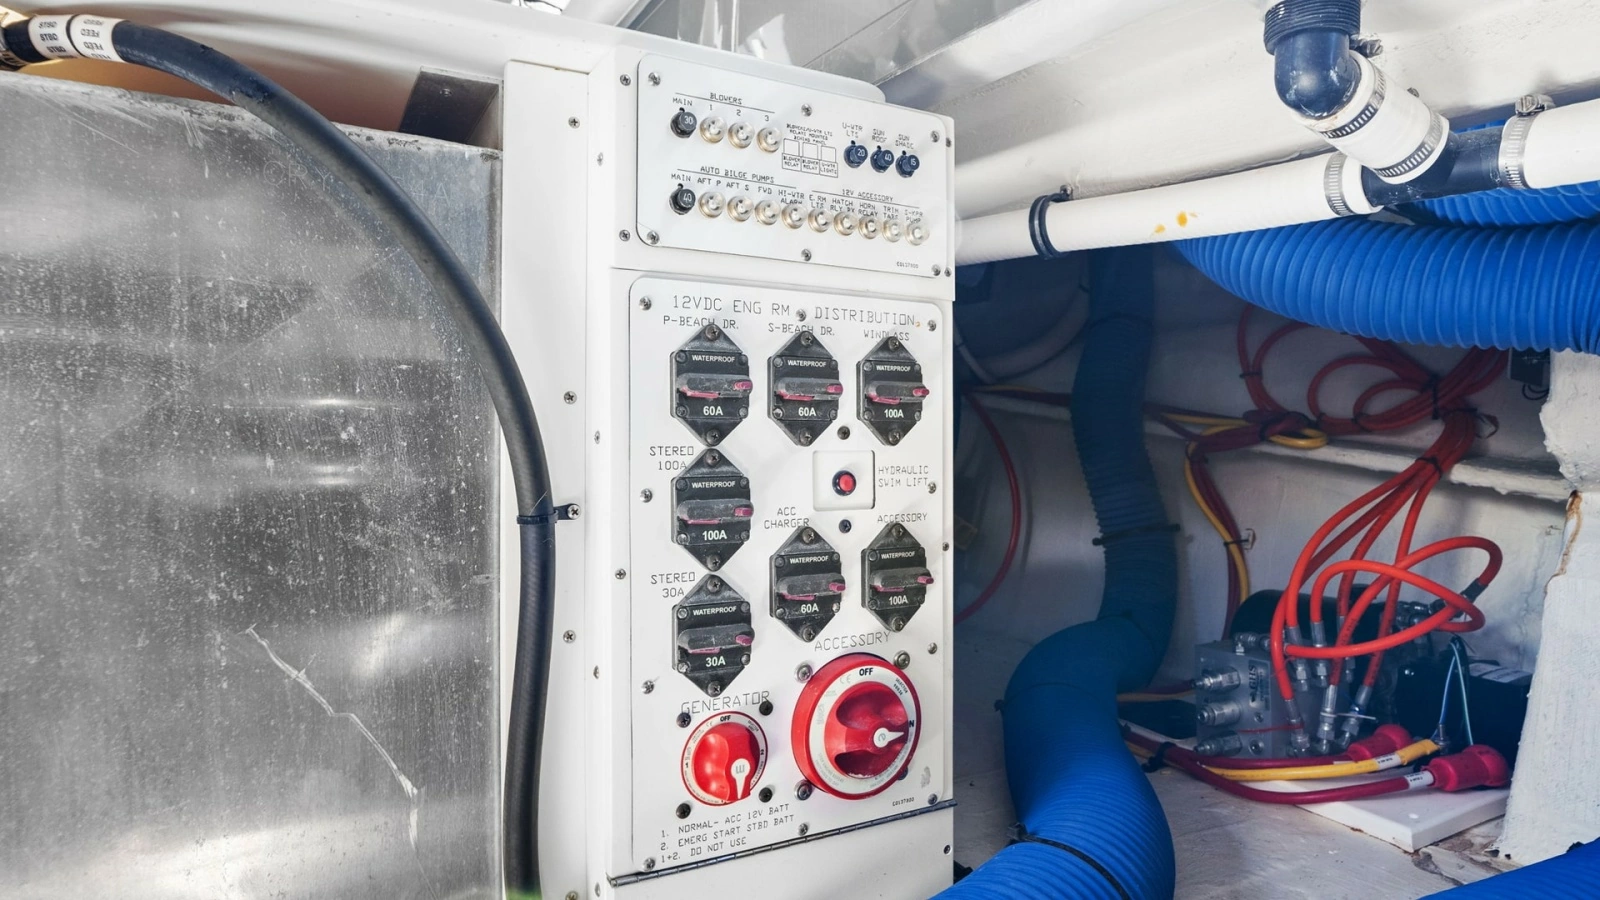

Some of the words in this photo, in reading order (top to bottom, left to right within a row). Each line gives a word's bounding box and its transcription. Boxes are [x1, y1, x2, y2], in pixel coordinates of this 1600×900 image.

[40, 33, 58, 41] STBD
[80, 28, 100, 37] FEED
[83, 41, 104, 50] FEED
[672, 97, 693, 106] MAIN
[709, 92, 743, 105] BLOWERS
[684, 116, 694, 125] 30
[842, 122, 863, 131] U-WTR
[846, 130, 859, 138] LTS
[871, 135, 887, 143] ROOF
[857, 148, 866, 156] 20
[671, 173, 691, 182] MAIN
[700, 166, 720, 175] AUTO
[724, 169, 747, 179] BILGE
[751, 173, 775, 183] PUMPS
[697, 177, 712, 185] AFT
[758, 186, 772, 195] FWD
[778, 189, 805, 200] HI-WTR
[842, 188, 854, 196] 12V
[858, 192, 893, 202] ACCESSORY
[683, 193, 692, 201] 40
[832, 198, 854, 206] HATCH
[830, 204, 842, 212] RLY
[860, 202, 876, 210] HORN
[883, 205, 899, 213] TRIM
[858, 209, 878, 217] RELAY
[673, 295, 722, 312] 12VDC
[733, 299, 762, 315] ENG
[771, 303, 790, 316] RM
[815, 306, 915, 326] DISTRIBUTION
[663, 315, 715, 327] P-BEACH
[722, 319, 739, 330] DR.
[768, 323, 814, 334] S-BEACH
[820, 326, 835, 336] DR.
[691, 354, 736, 363] WATERPROOF
[787, 359, 827, 368] WATERPROOF
[876, 364, 911, 372] WATERPROOF
[703, 405, 723, 416] 60A
[798, 406, 816, 417] 60A
[884, 408, 904, 419] 100A
[649, 446, 694, 457] STEREO
[658, 460, 688, 471] 100A
[878, 465, 929, 475] HYDRAULIC
[691, 480, 736, 489] WATERPROOF
[878, 478, 901, 488] SWIM
[906, 477, 928, 487] LIFT
[777, 506, 797, 517] ACC
[877, 512, 928, 524] ACCESSORY
[764, 518, 810, 530] CHARGER
[702, 529, 727, 541] 100A
[789, 555, 829, 564] WATERPROOF
[881, 551, 916, 560] WATERPROOF
[651, 571, 695, 585] STEREO
[662, 587, 685, 598] 30A
[888, 595, 909, 605] 100A
[693, 606, 737, 616] WATERPROOF
[801, 603, 819, 614] 60A
[814, 631, 891, 652] ACCESSORY
[705, 656, 726, 667] 30A
[859, 667, 874, 677] OFF
[681, 690, 770, 715] GENERATOR
[720, 714, 731, 722] OFF
[661, 830, 669, 838] 1.
[725, 813, 742, 824] ACC
[748, 810, 763, 820] 12V
[769, 803, 790, 815] BATT
[660, 842, 668, 851] 2.
[678, 833, 708, 847] EMERG
[713, 826, 741, 840] START
[747, 820, 768, 832] STBD
[774, 814, 795, 826] BATT
[690, 846, 702, 856] DO
[707, 842, 724, 852] NOT
[730, 836, 747, 848] USE
